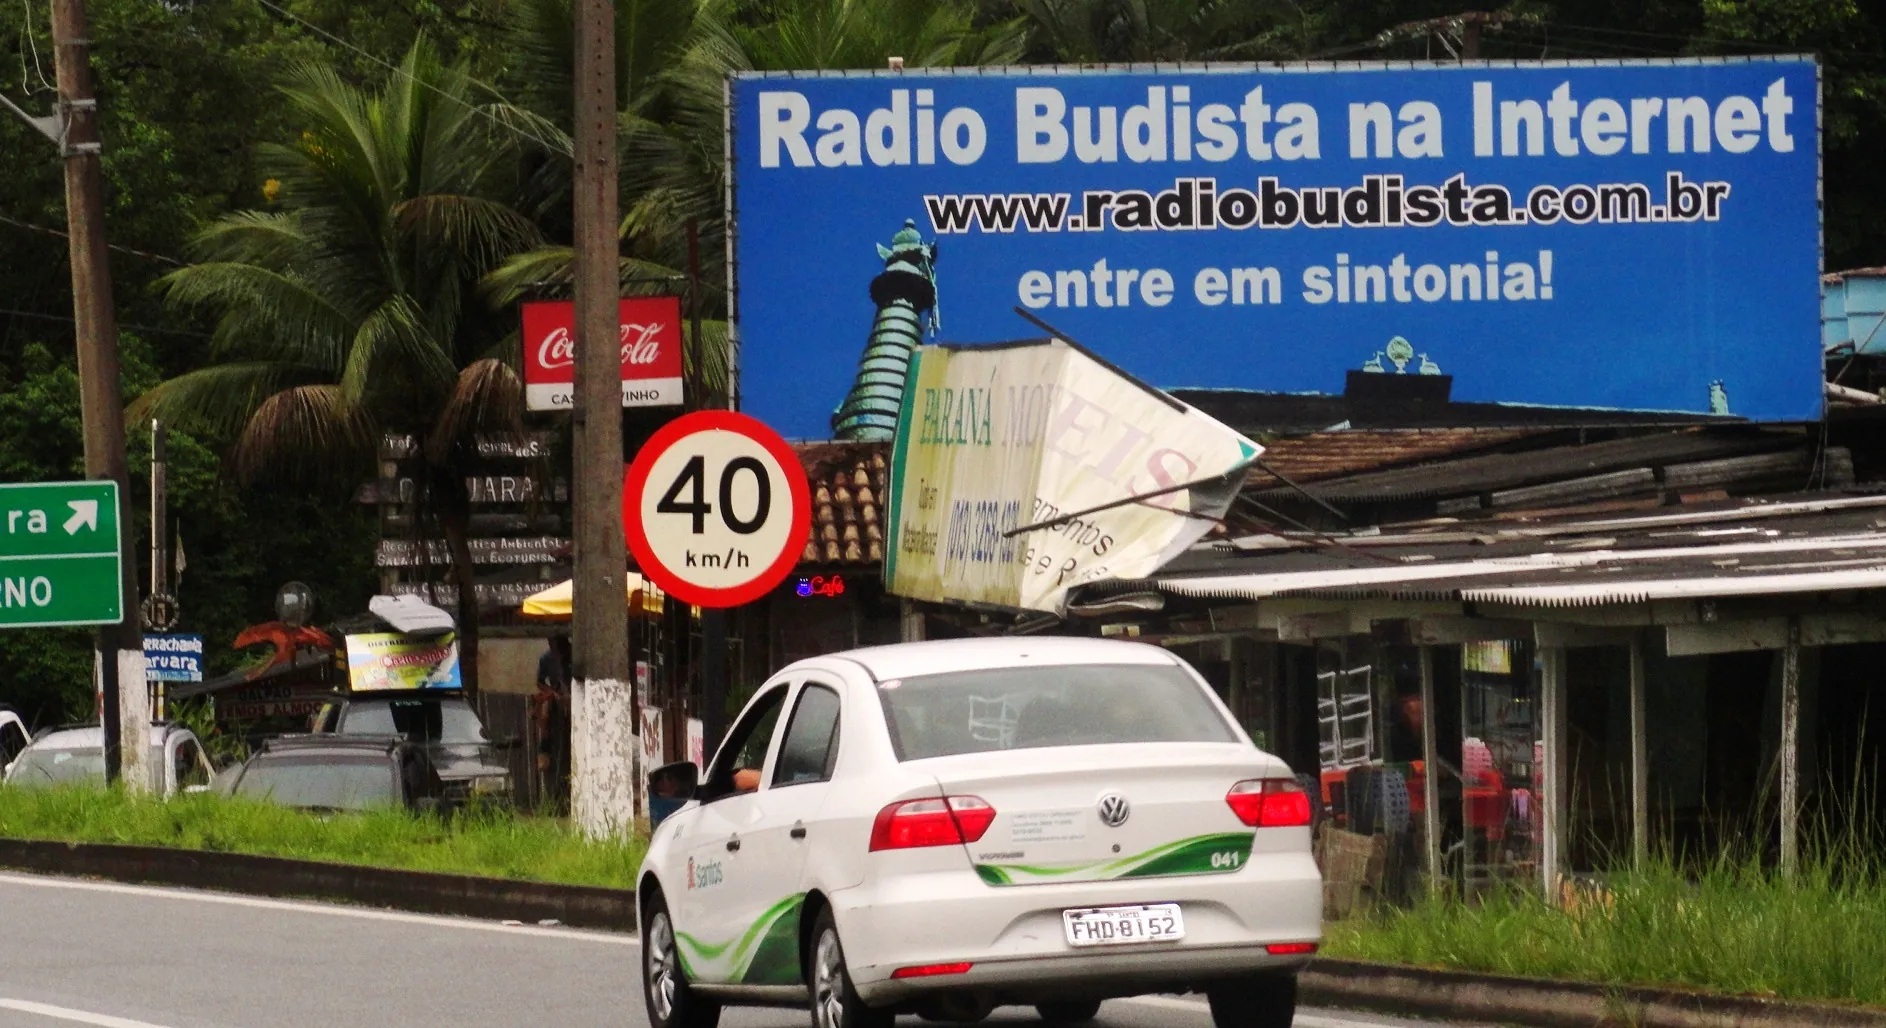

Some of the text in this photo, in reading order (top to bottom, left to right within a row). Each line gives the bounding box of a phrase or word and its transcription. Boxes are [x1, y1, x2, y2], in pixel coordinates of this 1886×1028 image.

[758, 77, 1795, 168] Radio Budista na Internet
[923, 171, 1730, 234] www.radiobudista.com.br
[1018, 249, 1553, 308] entre em sintonia!
[919, 365, 997, 446] PARANÁ
[656, 455, 771, 534] 40
[686, 547, 749, 569] km/h
[0, 576, 53, 609] NO
[1211, 851, 1239, 868] 041
